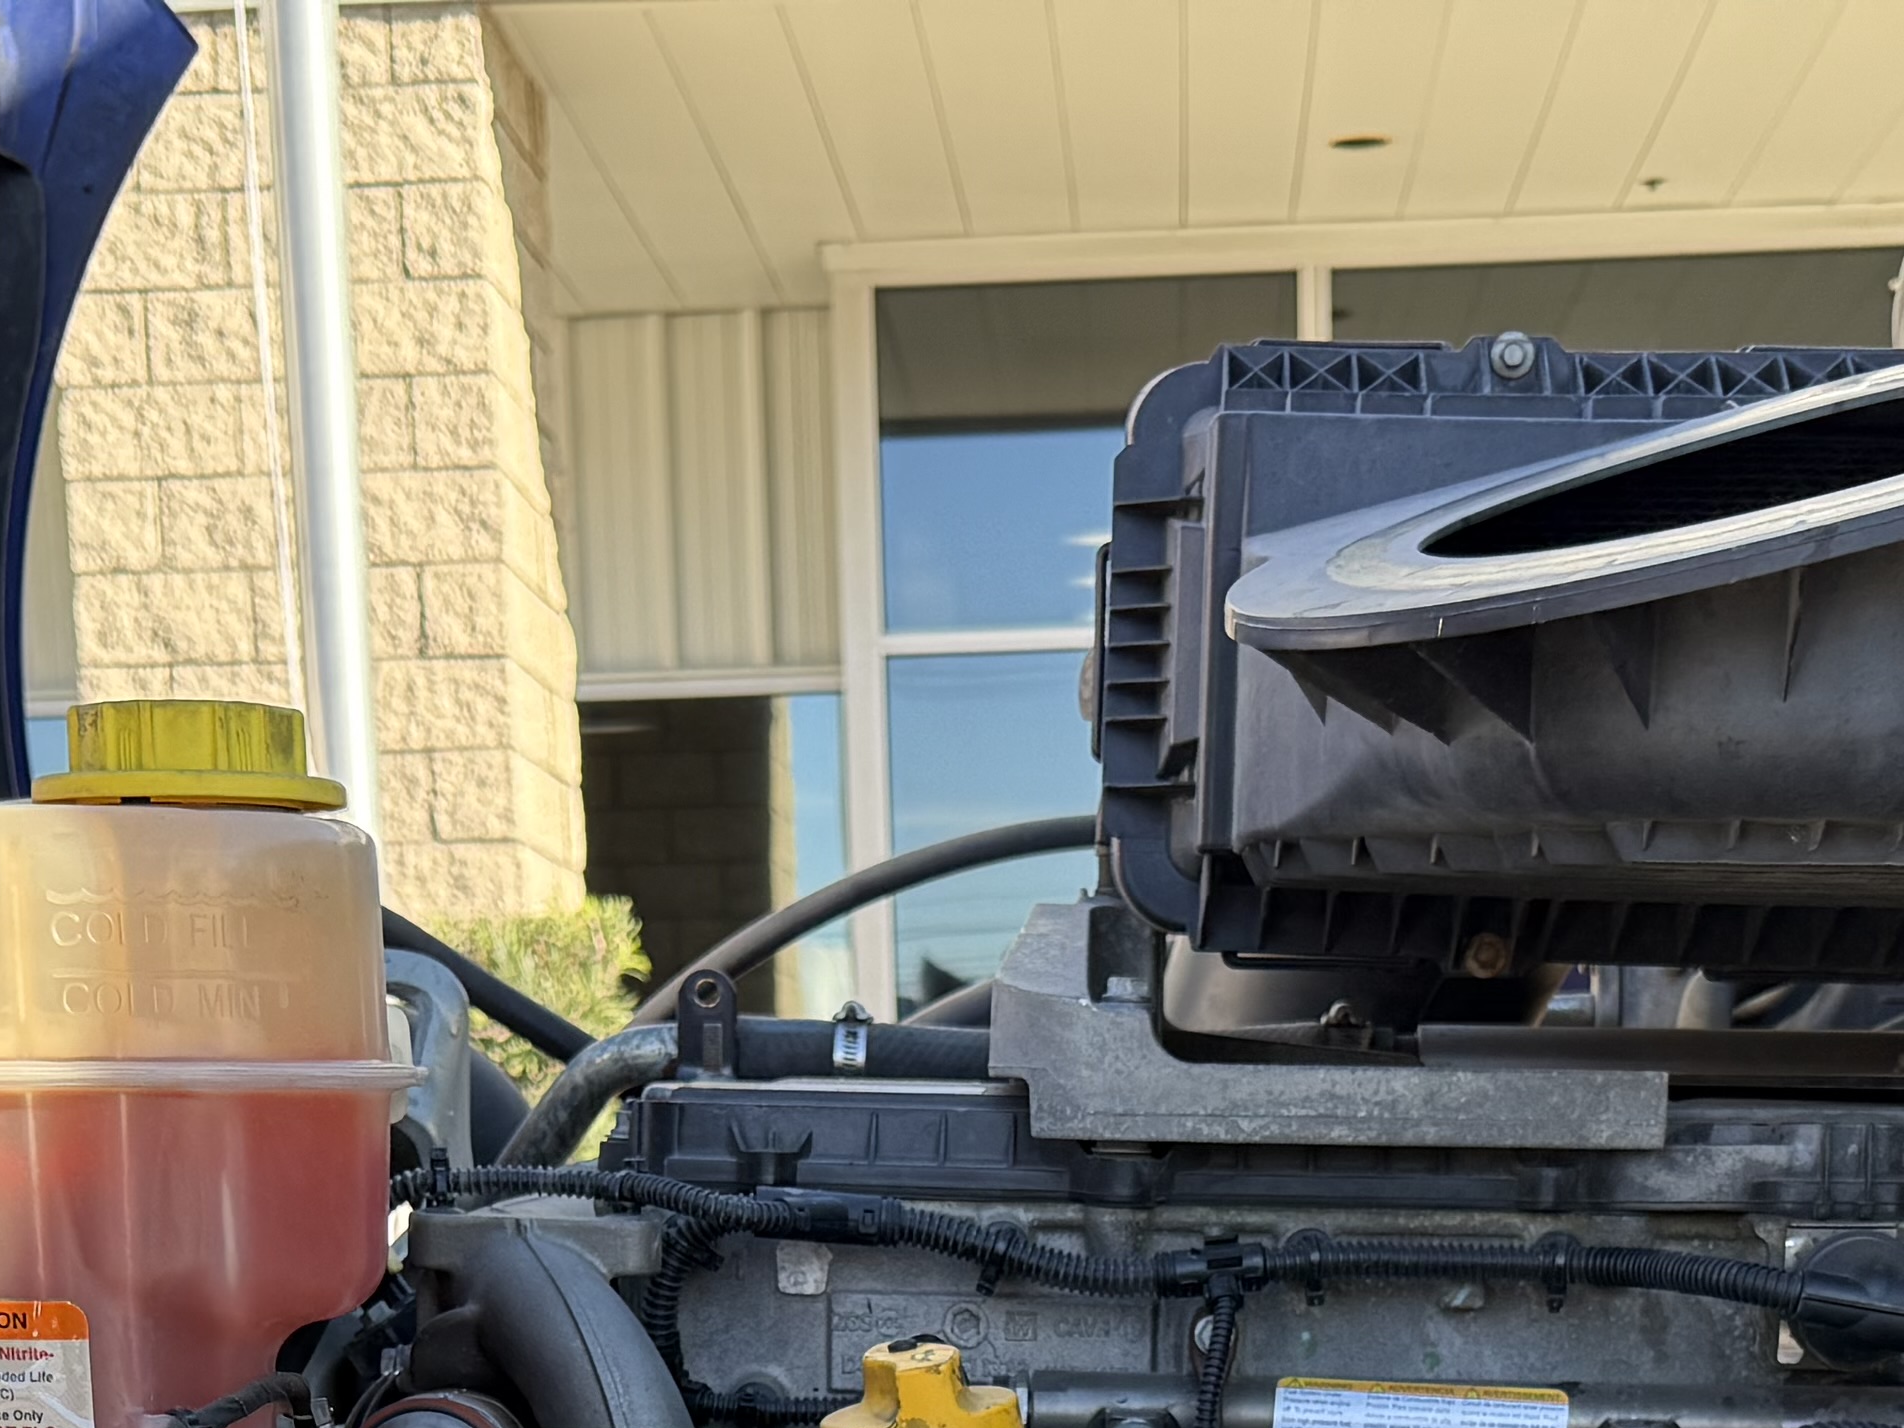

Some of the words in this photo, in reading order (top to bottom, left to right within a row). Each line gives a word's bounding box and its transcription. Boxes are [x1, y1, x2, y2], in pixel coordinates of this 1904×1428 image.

[51, 911, 169, 946] COLD
[63, 983, 175, 1015] COLD
[199, 983, 260, 1018] MIN
[0, 1347, 54, 1361] Nitrite-
[30, 1372, 53, 1383] Life
[13, 1410, 43, 1423] Only
